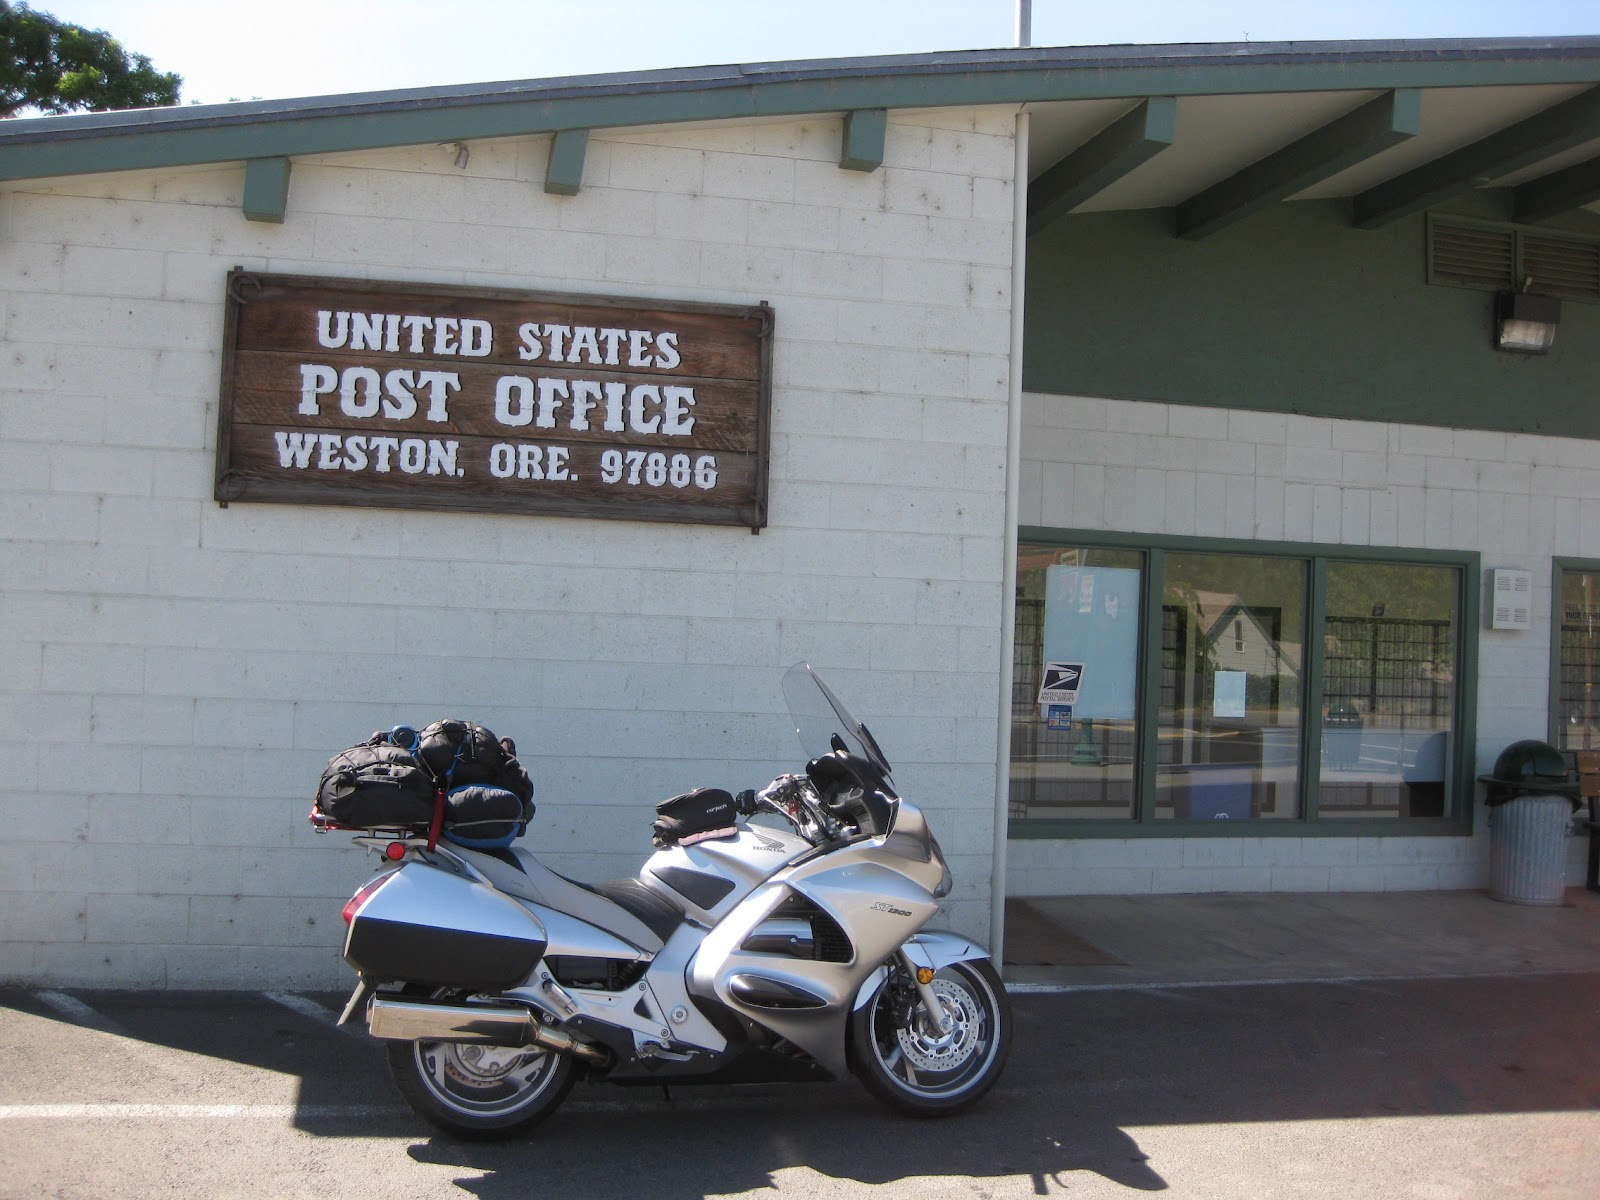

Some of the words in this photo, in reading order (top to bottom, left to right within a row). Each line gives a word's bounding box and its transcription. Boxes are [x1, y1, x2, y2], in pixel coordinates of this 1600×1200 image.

[317, 310, 494, 357] UNITED
[518, 322, 682, 370] STATES
[298, 364, 463, 423] POST
[494, 375, 697, 437] OFFICE
[489, 443, 579, 482] ORE.
[601, 449, 719, 490] 97886
